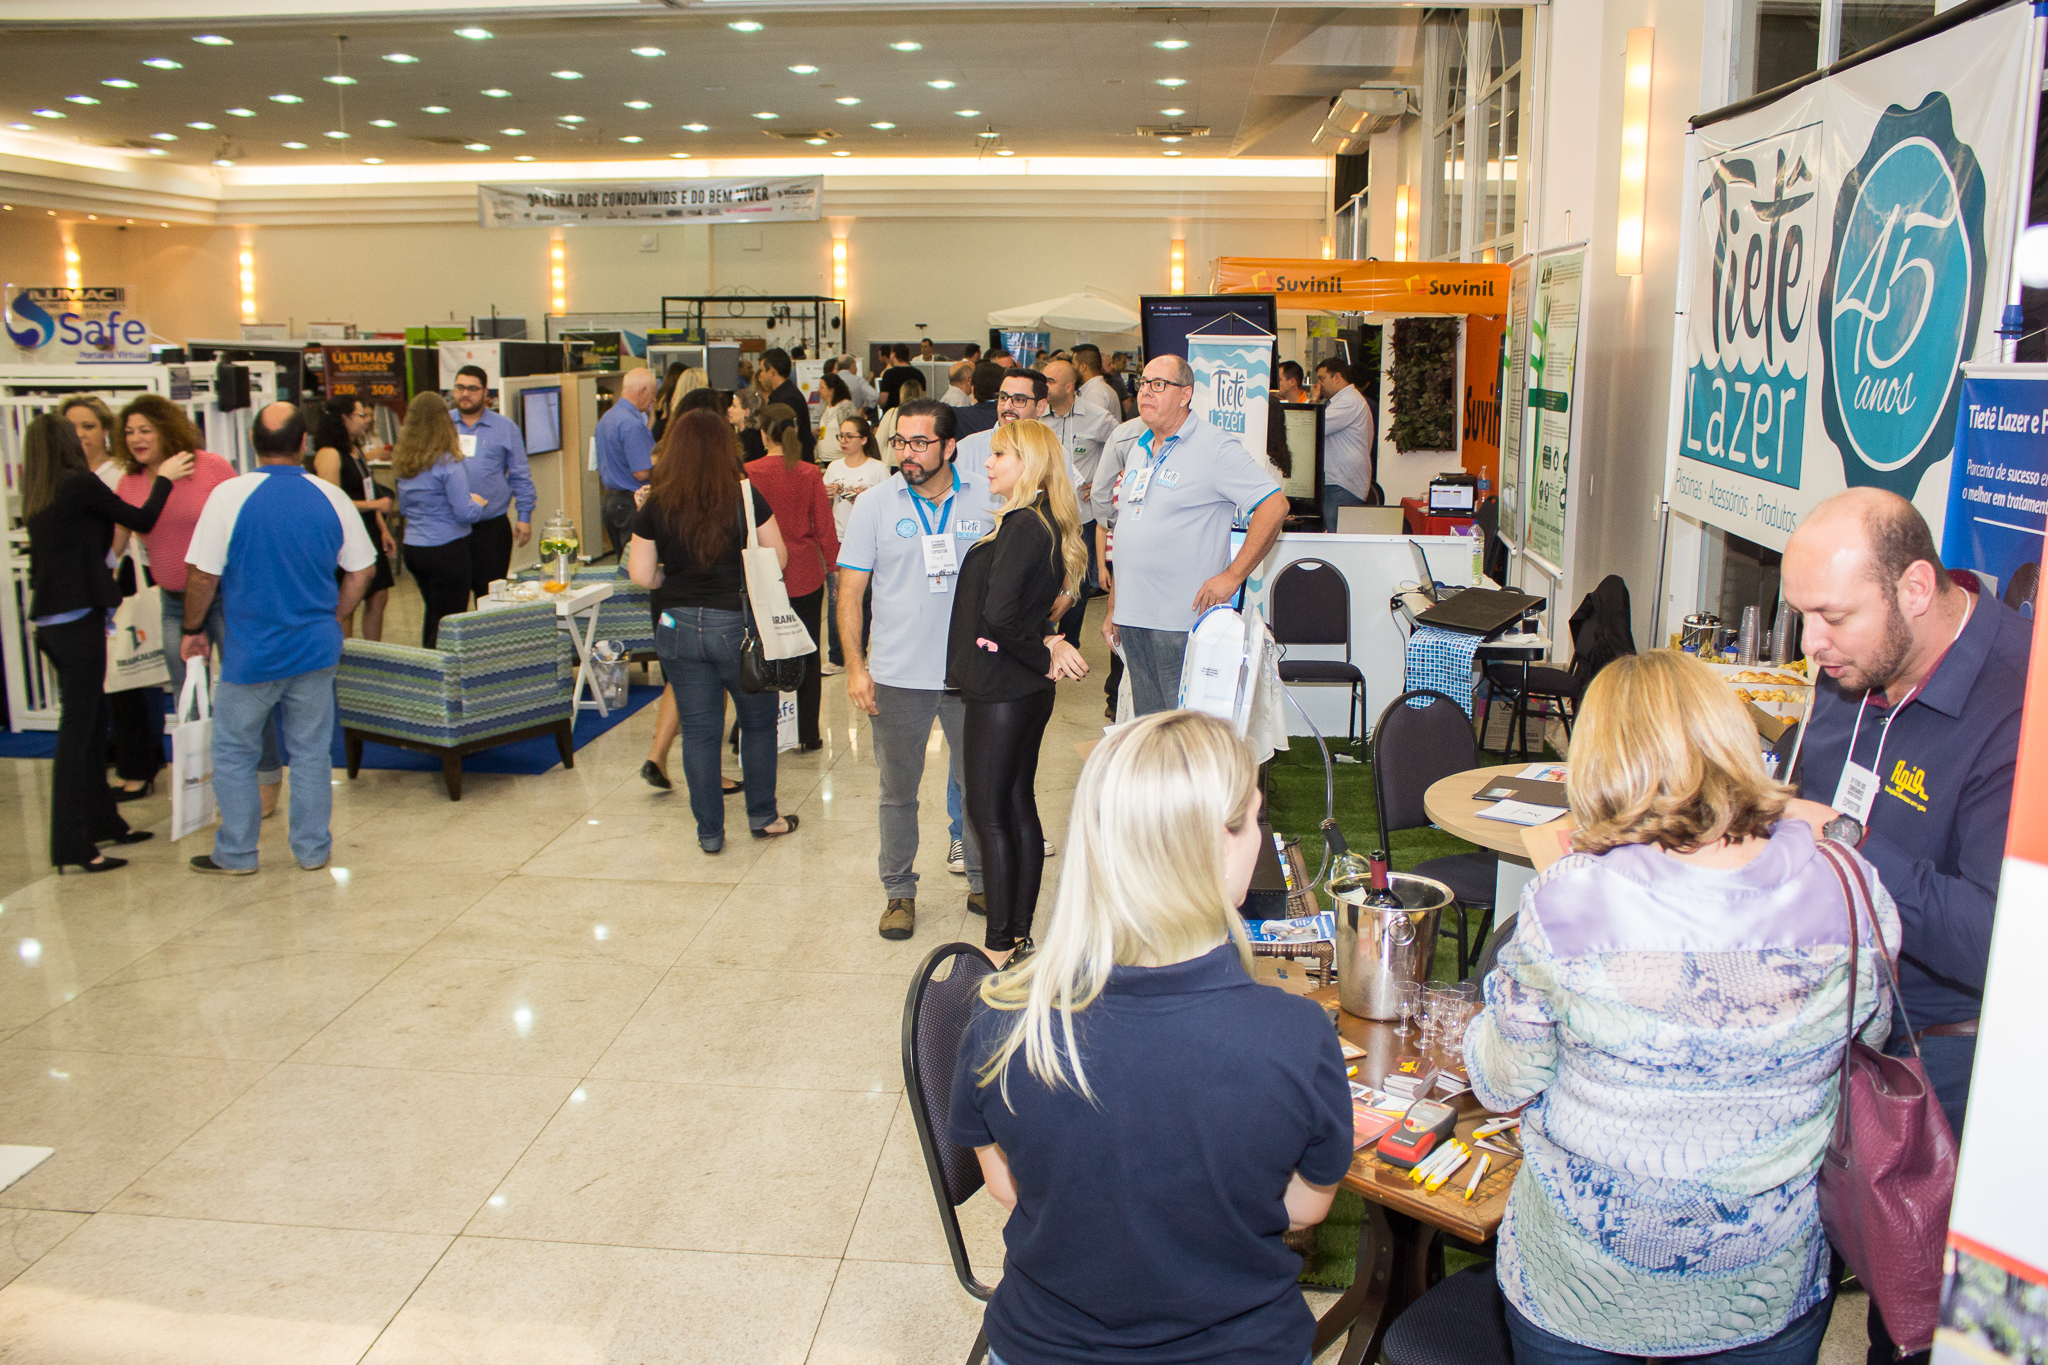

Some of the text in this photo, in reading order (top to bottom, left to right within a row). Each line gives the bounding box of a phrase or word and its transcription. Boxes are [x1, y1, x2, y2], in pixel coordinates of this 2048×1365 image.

[542, 193, 574, 207] FEIRA
[577, 191, 599, 207] DOS
[602, 189, 677, 207] CONDOMÍNIOS
[680, 190, 688, 205] E
[691, 190, 705, 204] DO
[708, 189, 733, 204] BEM
[1699, 147, 1815, 367] Tietê
[1276, 276, 1342, 293] Suvinil
[1429, 279, 1494, 297] Suvinil
[1834, 202, 1960, 374] 45
[59, 311, 146, 346] Safe
[331, 349, 395, 364] ÚLTIMAS
[339, 363, 388, 372] UNIDADES
[1212, 368, 1246, 411] Tietê
[1854, 372, 1917, 416] anos
[1685, 372, 1797, 475] Lazer
[1969, 404, 1997, 431] Tietê
[1997, 406, 2031, 433] Lazer
[2030, 414, 2040, 434] e
[1966, 458, 1996, 479] Parceria
[1995, 463, 2007, 481] de
[2006, 467, 2040, 486] sucesso
[1675, 467, 1798, 534] Piscinas Acessórios Produtos
[1962, 487, 1968, 500] o
[1968, 485, 1993, 505] melhor
[1992, 491, 2006, 507] em
